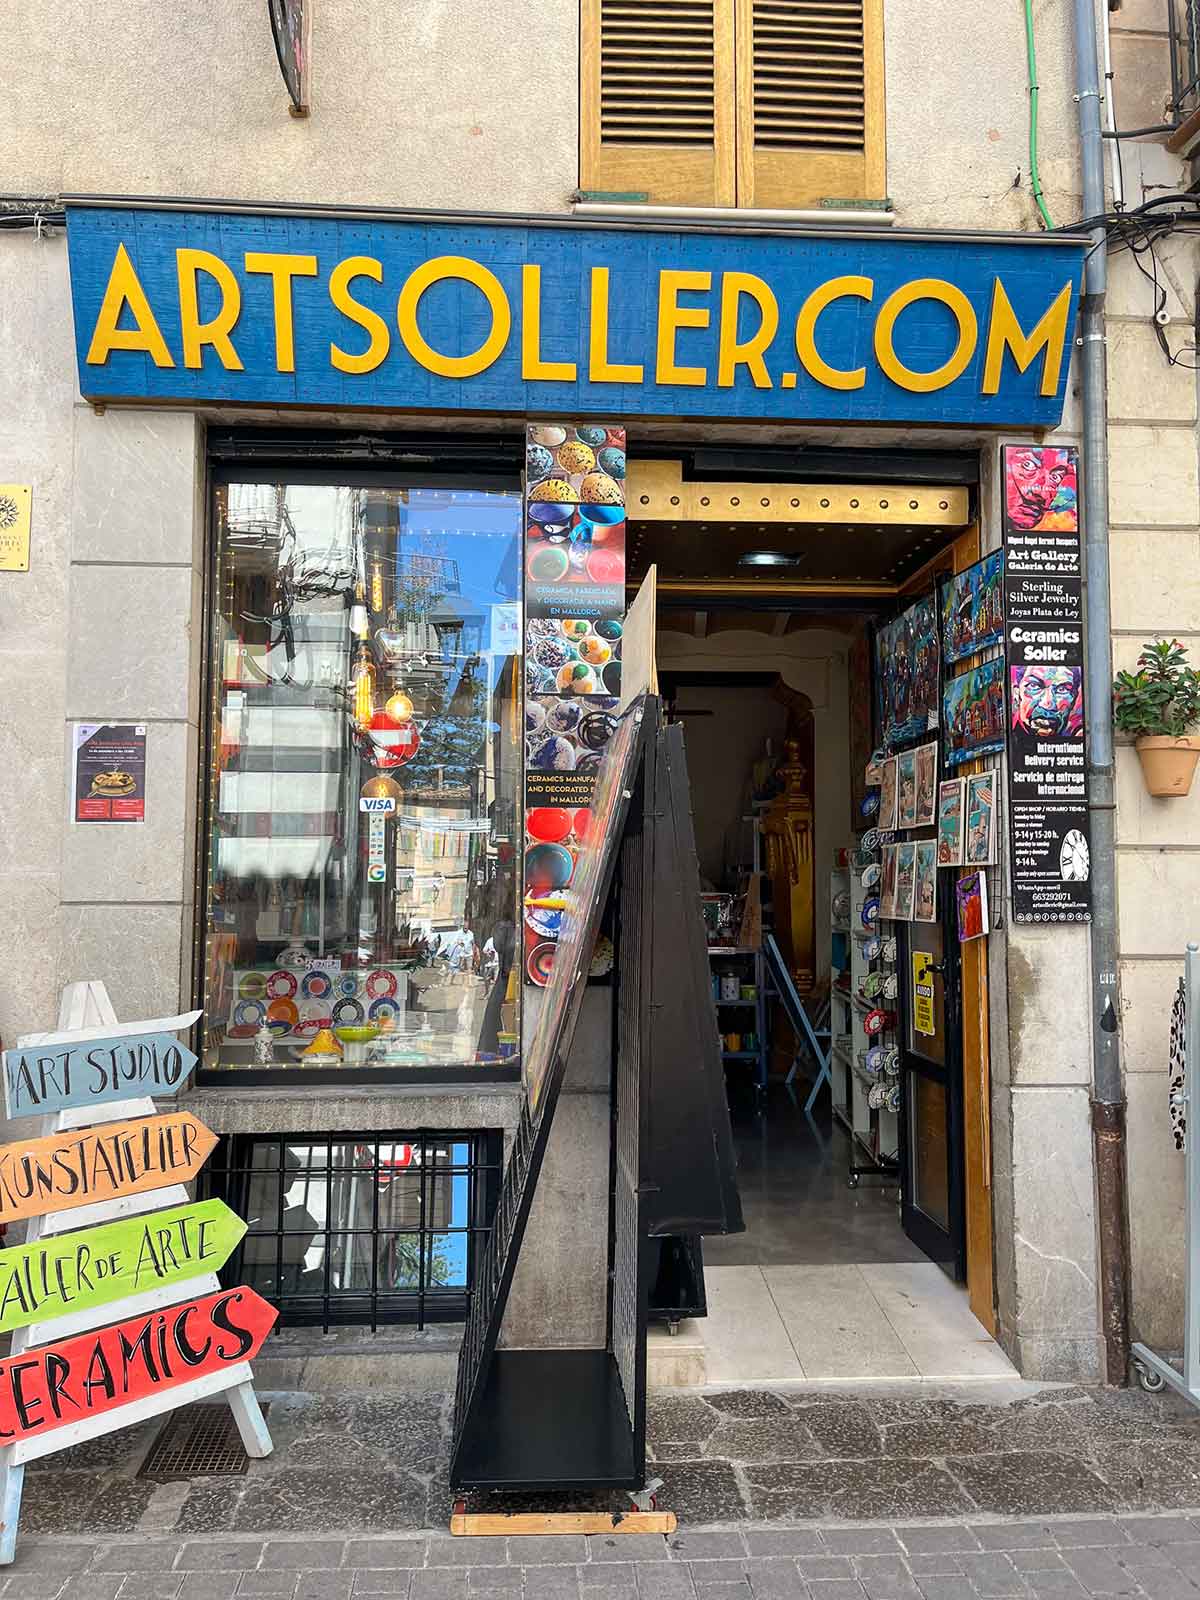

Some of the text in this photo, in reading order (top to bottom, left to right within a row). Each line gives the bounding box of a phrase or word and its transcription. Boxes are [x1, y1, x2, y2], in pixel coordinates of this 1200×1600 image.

[86, 241, 1073, 397] ARTSOLLER.COM
[1008, 550, 1079, 562] Art Gallery
[1057, 563, 1079, 571] Arte
[1022, 581, 1063, 595] Sterling
[1009, 592, 1079, 606] Silver Jewelry
[562, 608, 601, 616] MALLORCA
[1010, 607, 1079, 618] Joyas Plata de Ley
[1010, 627, 1080, 643] Ceramics
[1023, 646, 1067, 660] Soller
[1037, 742, 1083, 753] International
[1056, 755, 1084, 766] service
[1013, 772, 1085, 783] Servicio de entrega
[364, 799, 392, 810] VISA
[1015, 830, 1029, 839] 9-14
[1035, 831, 1052, 839] 15-20
[1015, 858, 1030, 866] 9-14
[1032, 892, 1071, 901] 663292071
[16, 1042, 183, 1108] ART STUDIO
[0, 1244, 94, 1320] ALLER
[134, 1216, 216, 1289] ARTE
